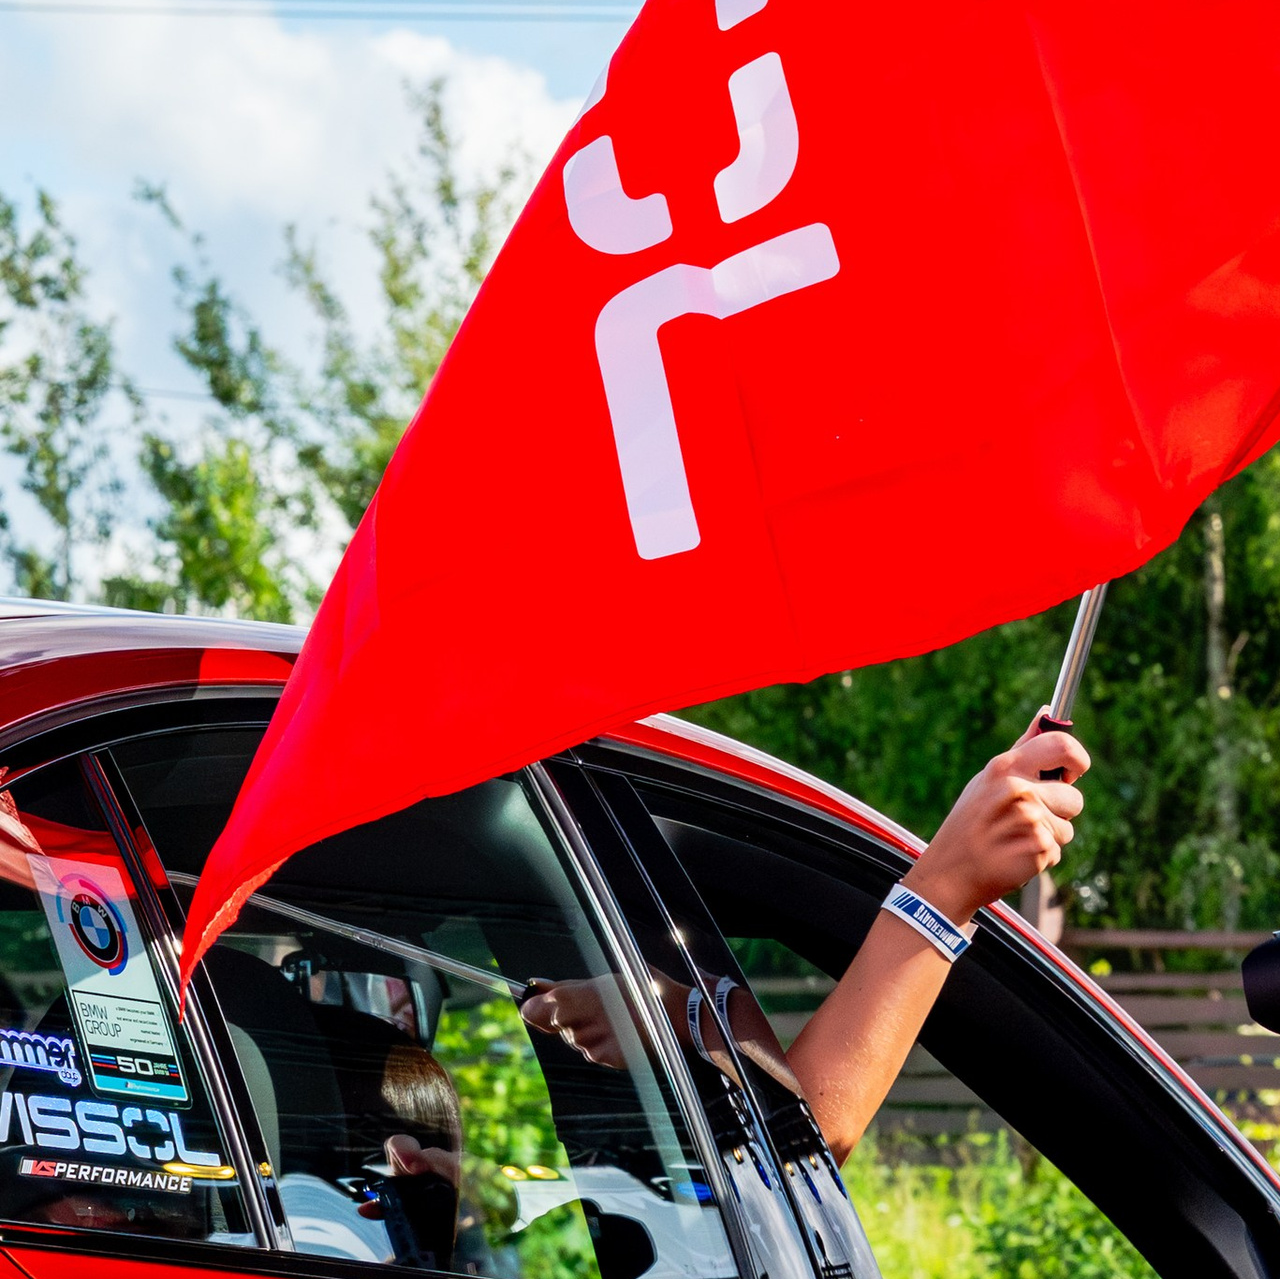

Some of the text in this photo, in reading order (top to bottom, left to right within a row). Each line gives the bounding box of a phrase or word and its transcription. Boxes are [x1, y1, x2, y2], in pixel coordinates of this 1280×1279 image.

[71, 895, 108, 919] BMW
[80, 1002, 109, 1021] BMW
[85, 1019, 122, 1039] GROUP
[116, 1055, 155, 1076] 50
[54, 1162, 193, 1192] PERFORMANCE
